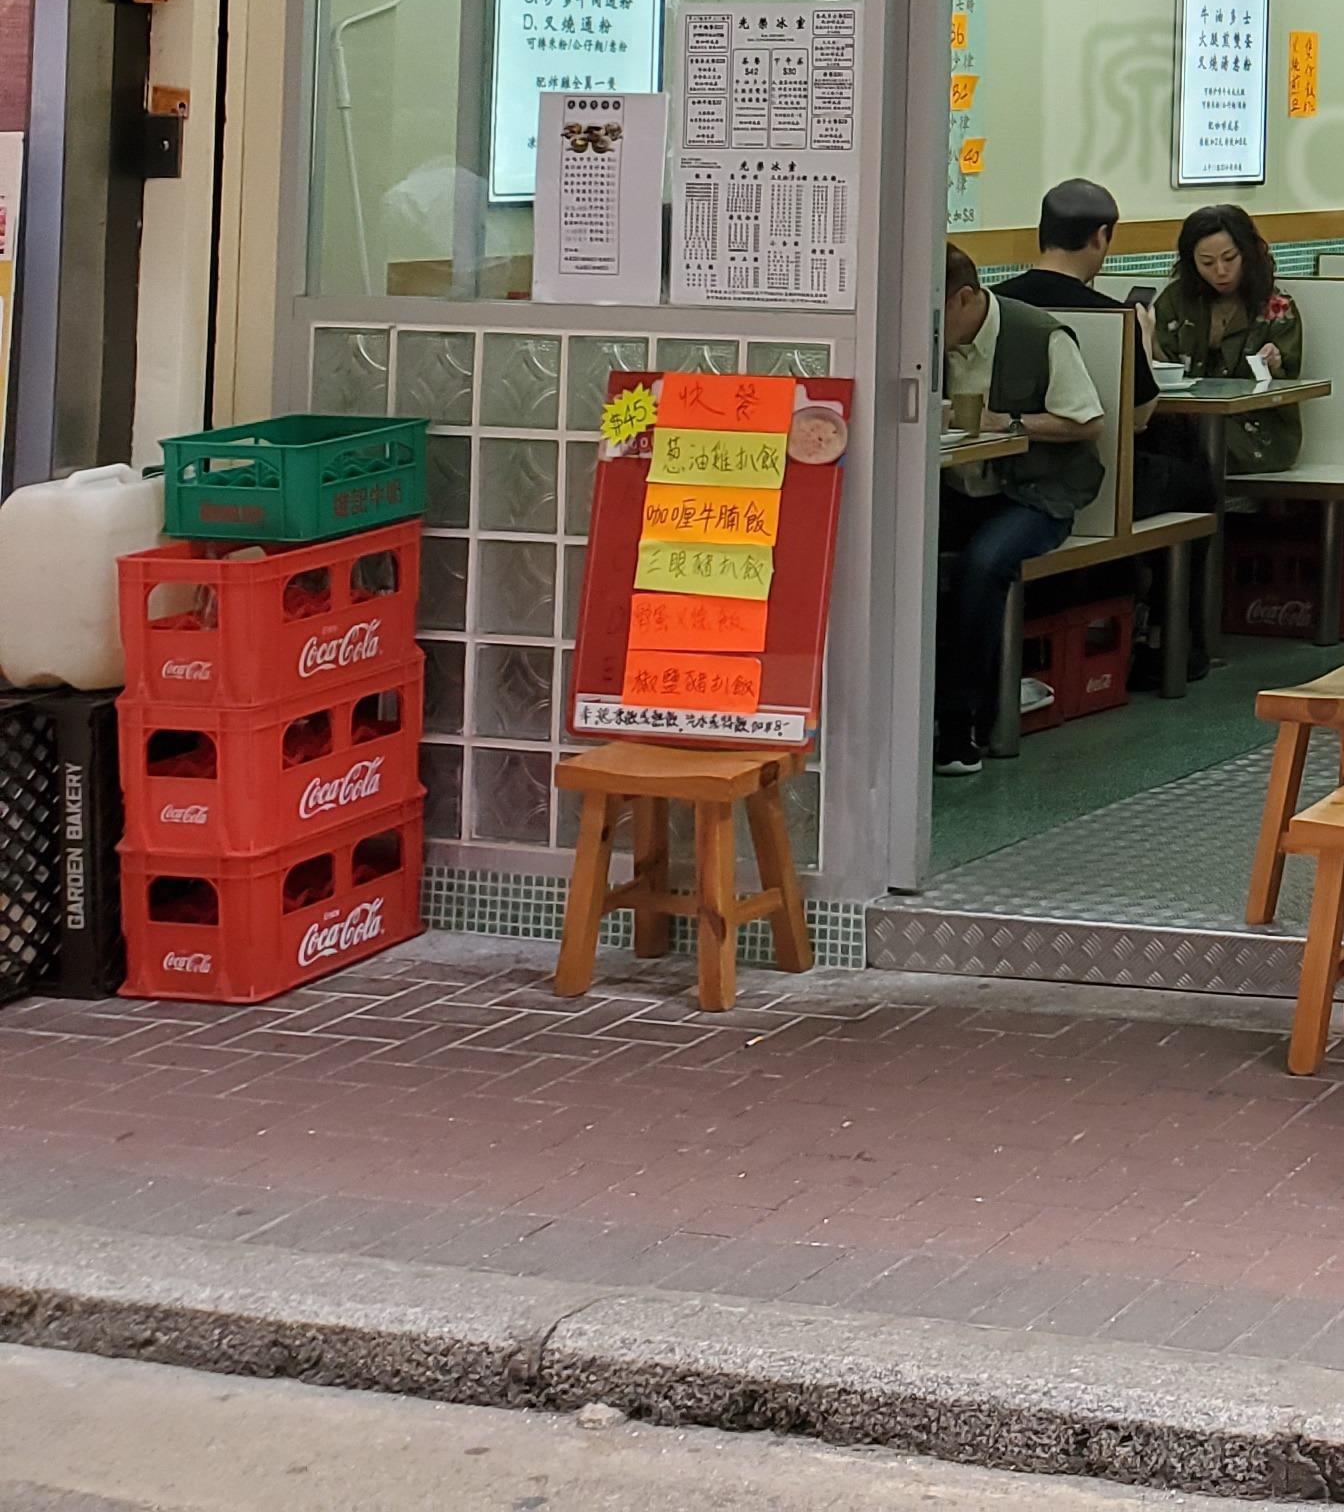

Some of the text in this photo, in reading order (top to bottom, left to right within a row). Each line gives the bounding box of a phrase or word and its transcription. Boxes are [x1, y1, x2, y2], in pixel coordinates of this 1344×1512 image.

[544, 15, 612, 35] 叉燒通粉
[610, 402, 647, 436] $45
[299, 619, 382, 678] Coca-Cola
[162, 660, 213, 680] Coca-Cola
[299, 756, 385, 819] Coca-Cola
[161, 803, 209, 824] Coca-Cola
[65, 762, 84, 929] GARDEN BAKERY
[298, 897, 385, 967] Coca-Cola
[163, 951, 212, 974] Coca-Cola
